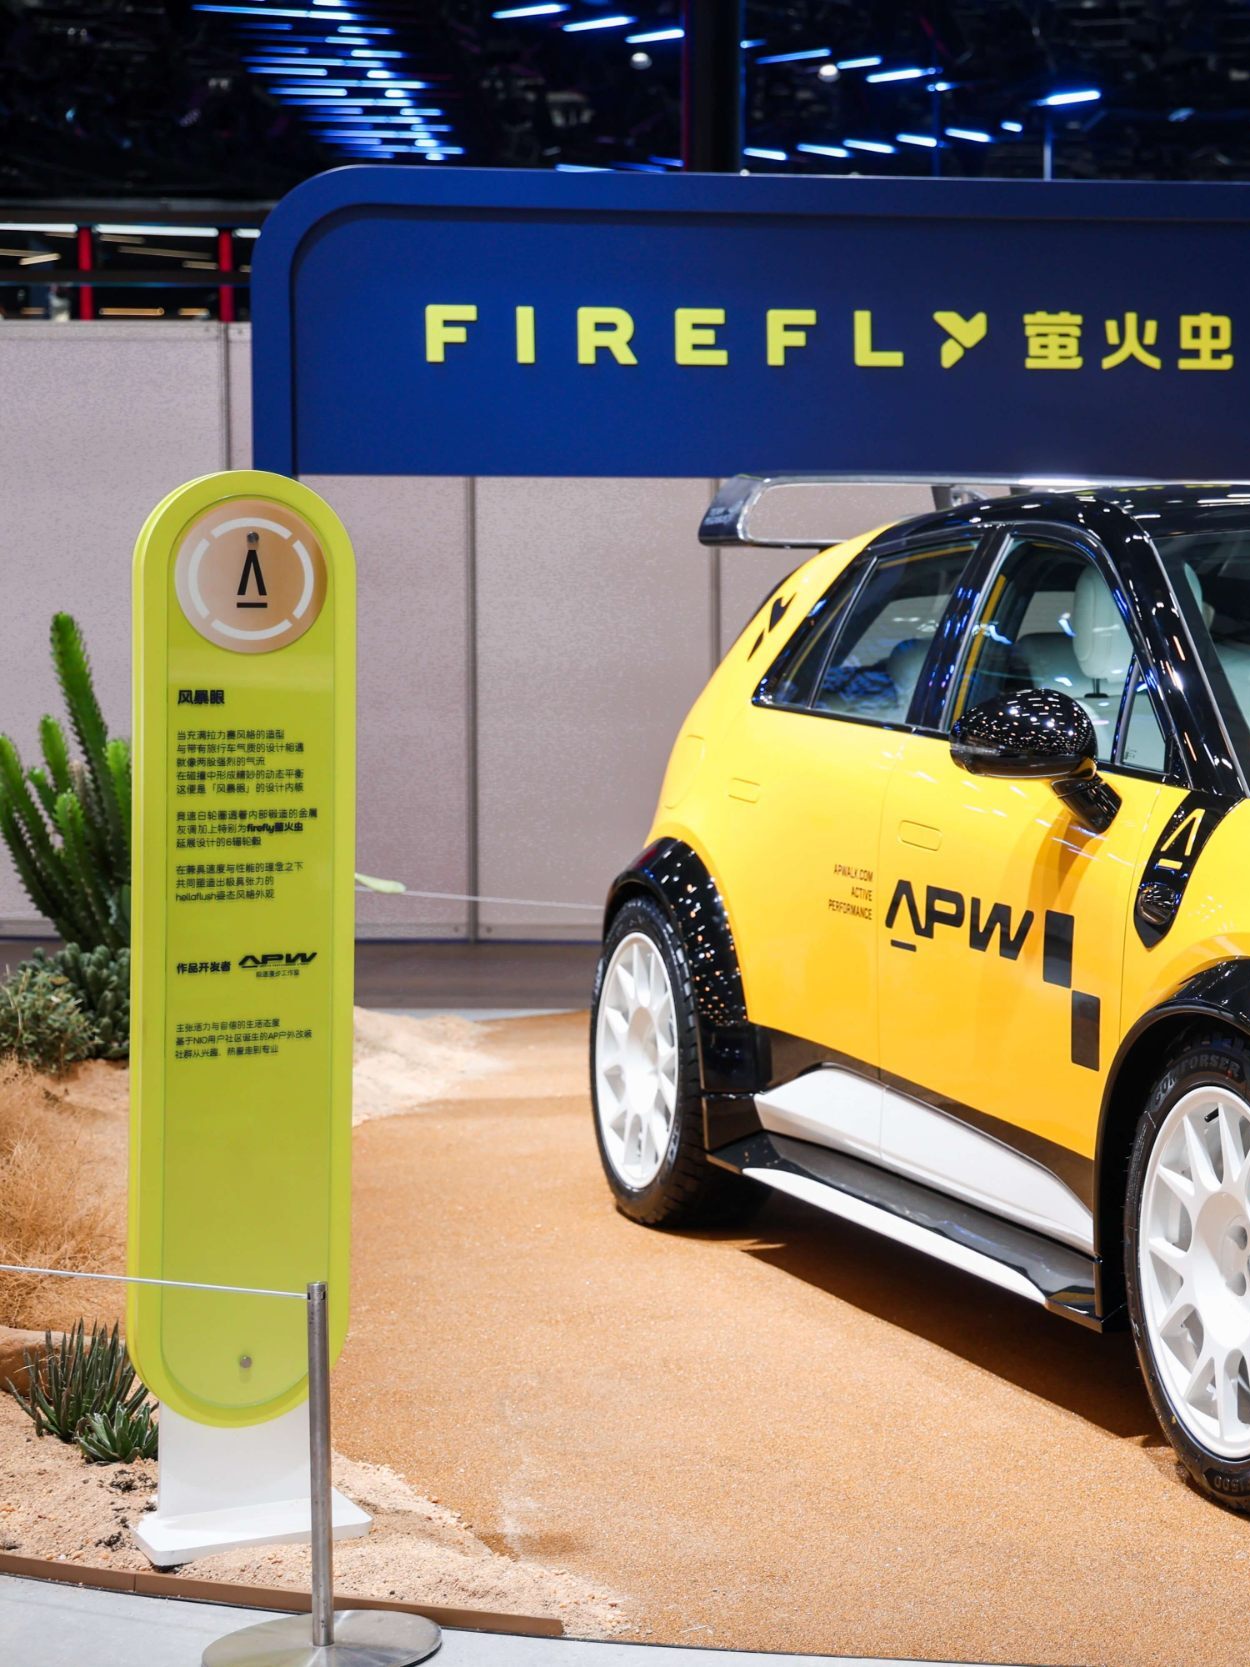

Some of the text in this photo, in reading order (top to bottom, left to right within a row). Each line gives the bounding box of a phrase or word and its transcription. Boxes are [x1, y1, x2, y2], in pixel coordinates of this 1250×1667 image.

[425, 304, 1234, 371] FIREFLY 萤火虫
[178, 689, 225, 705] 风暴眼
[828, 898, 873, 920] PERFORMANCE
[885, 878, 1035, 961] APW
[177, 952, 318, 975] 作品开发者 APW
